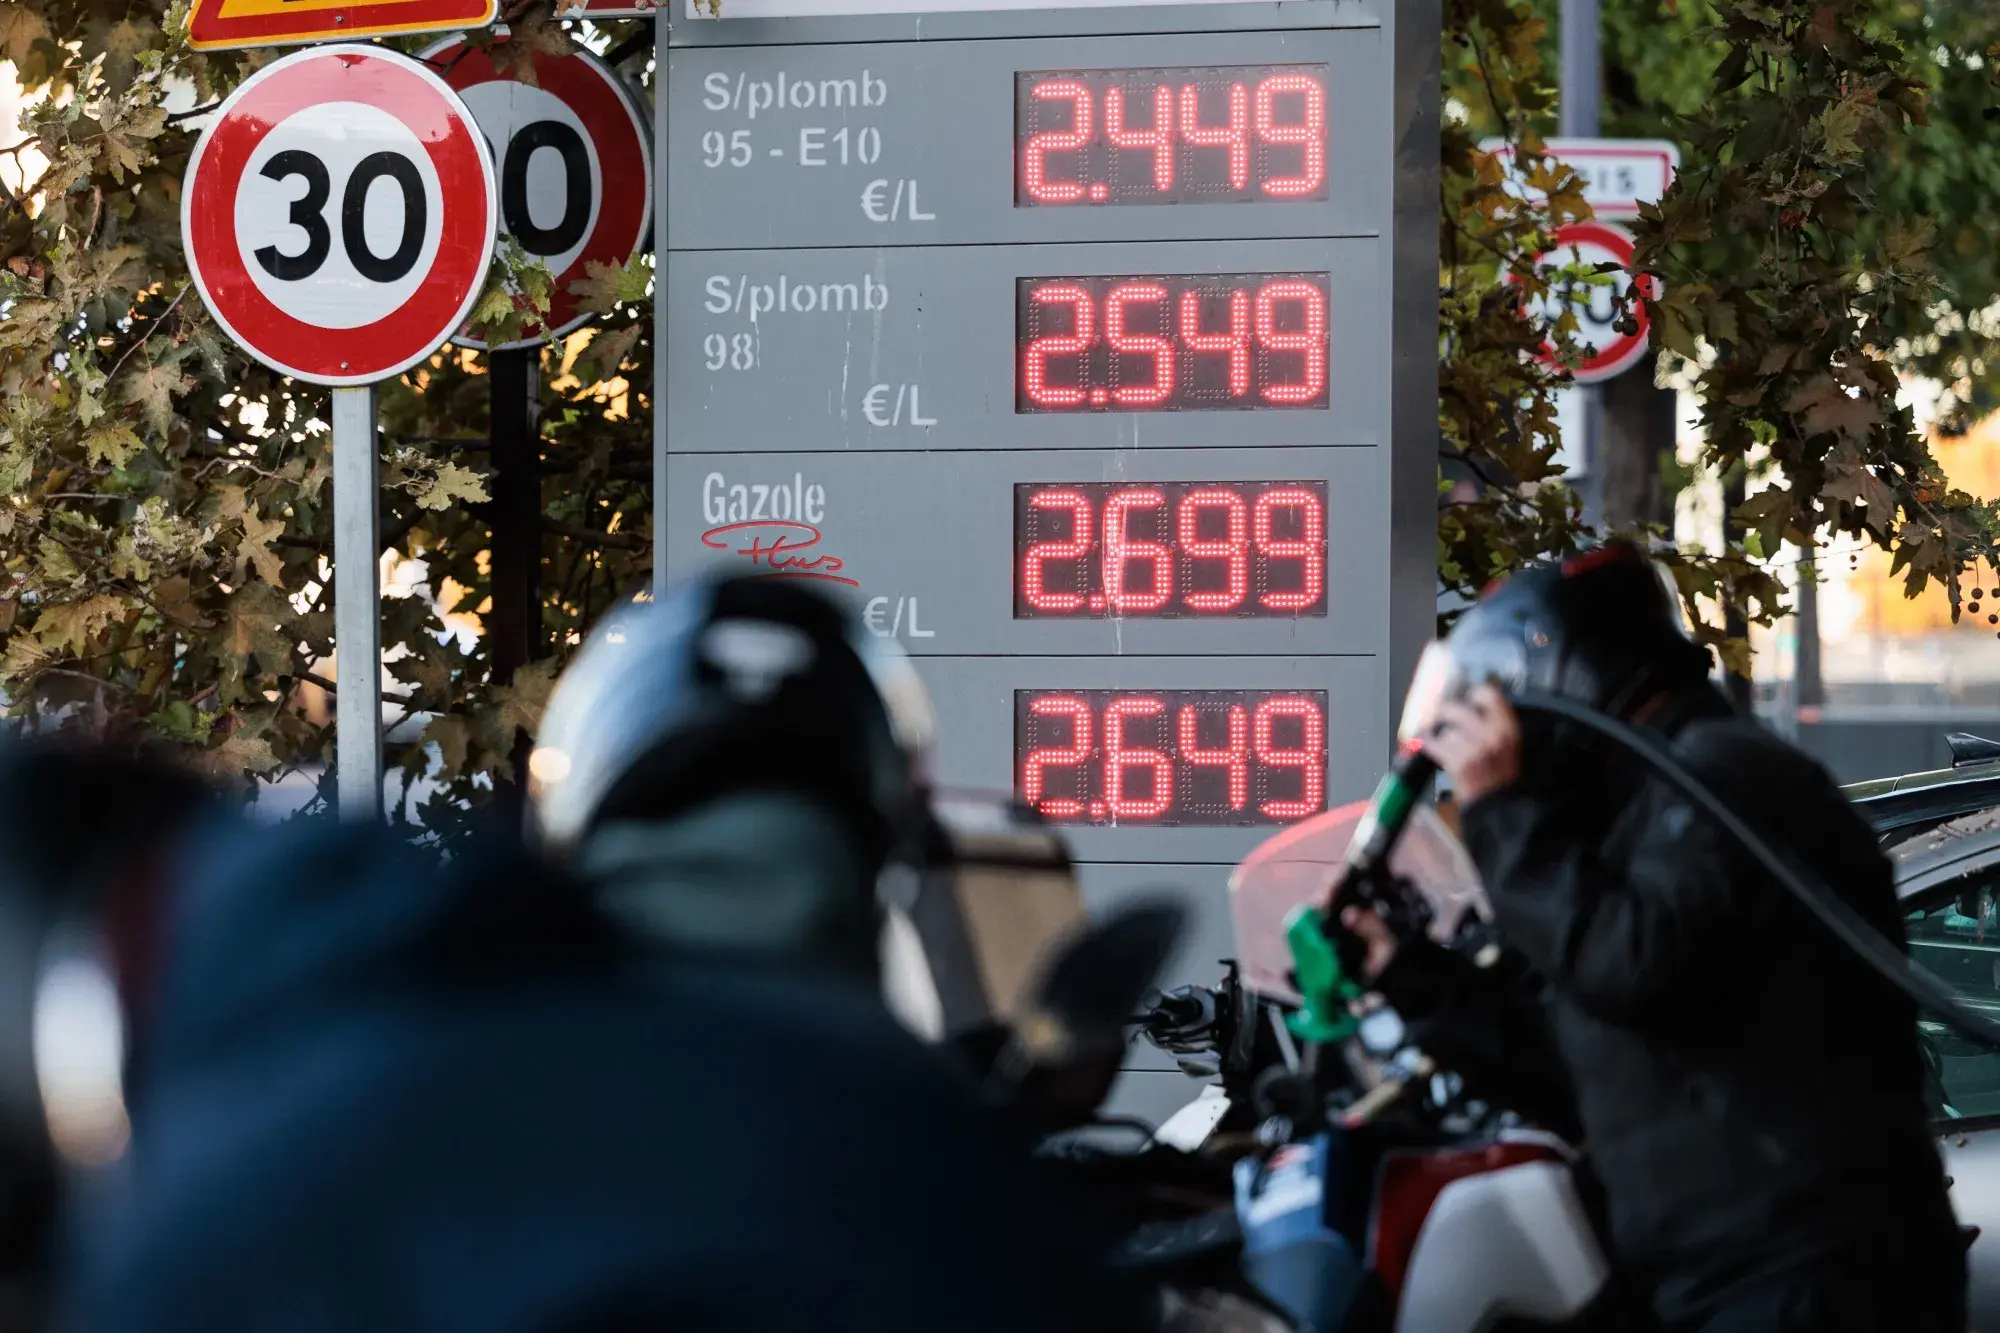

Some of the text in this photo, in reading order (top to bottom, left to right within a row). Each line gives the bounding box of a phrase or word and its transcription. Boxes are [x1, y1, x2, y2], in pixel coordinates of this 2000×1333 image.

[702, 69, 887, 119] S/plomb
[702, 130, 752, 168] 95
[799, 127, 881, 166] E10
[1024, 75, 1325, 200] 2.449
[485, 120, 592, 257] 0
[860, 178, 936, 222] €/L
[254, 149, 427, 283] 30
[704, 273, 889, 322] S/plomb
[703, 332, 754, 371] 98
[1024, 282, 1325, 402] 2.549
[861, 384, 937, 426] €/L
[703, 472, 826, 525] Gazole
[702, 520, 844, 570] Plus
[1024, 490, 1324, 609] 2.699
[862, 596, 936, 639] €/L
[1024, 698, 1324, 817] 2.649
